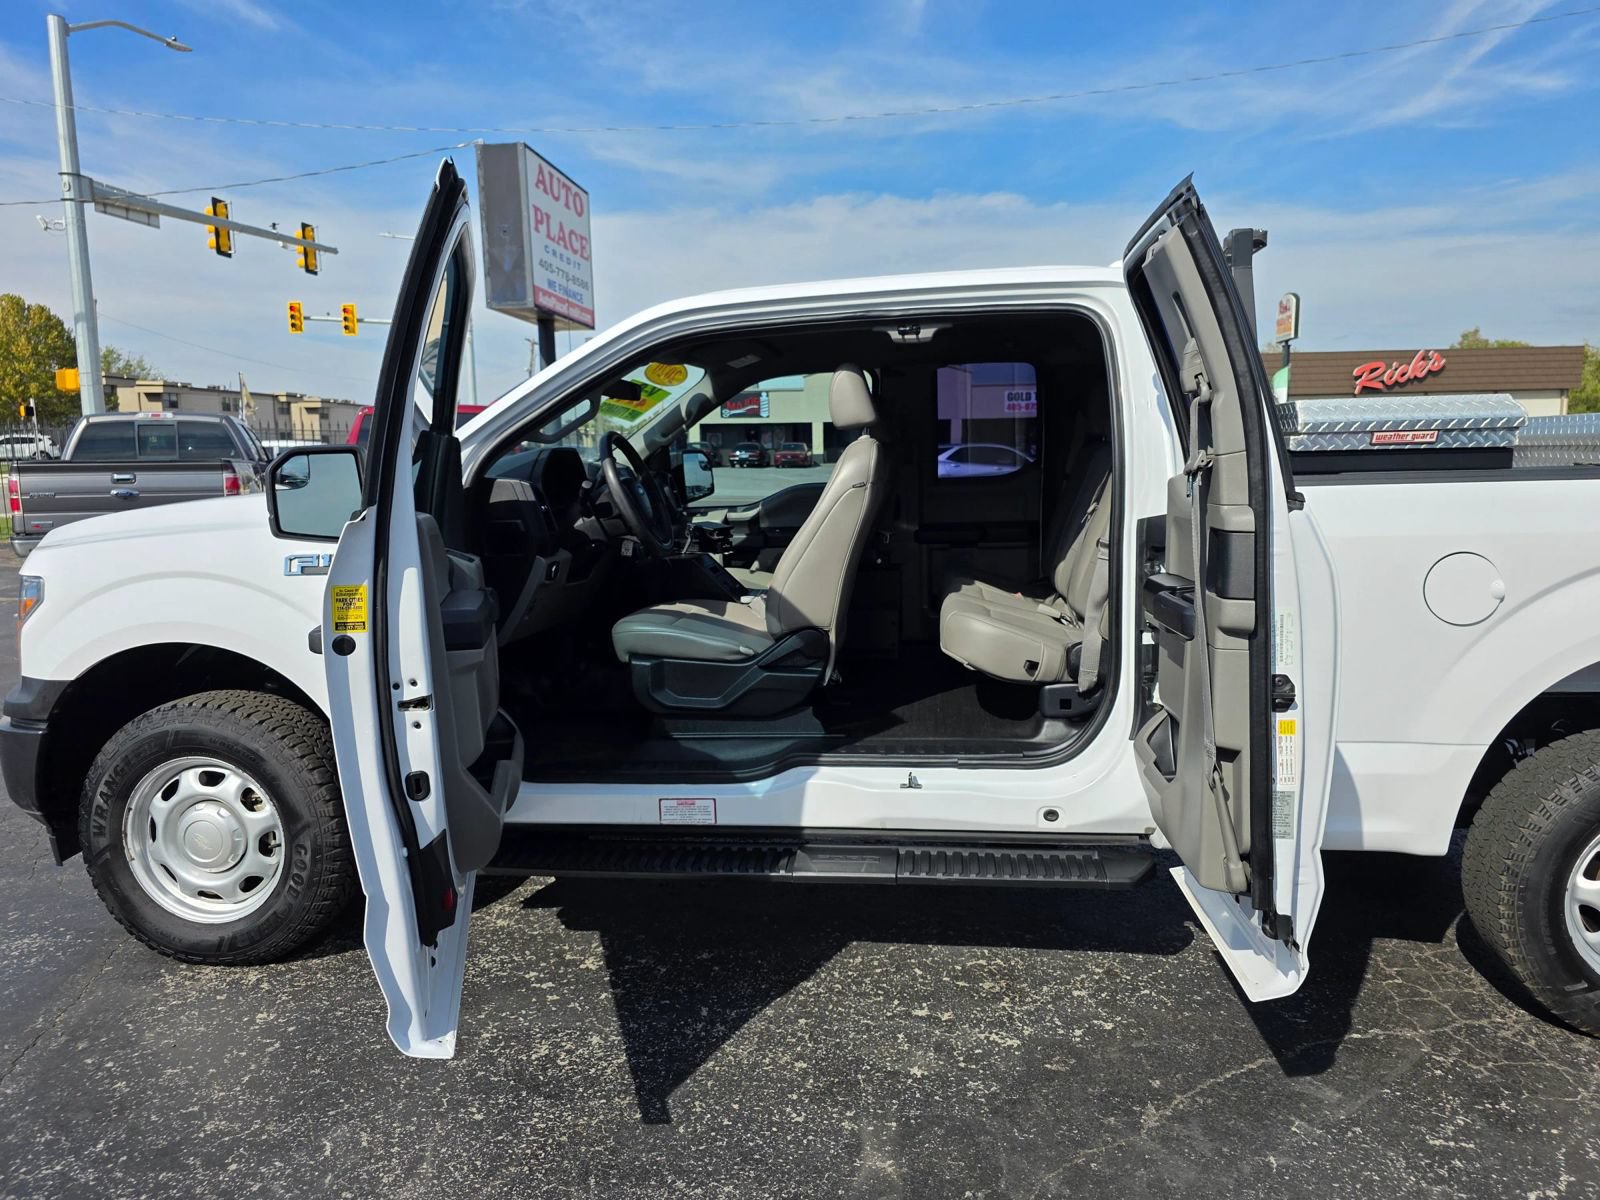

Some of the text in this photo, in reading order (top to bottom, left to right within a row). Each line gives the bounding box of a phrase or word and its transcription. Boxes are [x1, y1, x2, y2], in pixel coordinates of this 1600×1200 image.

[535, 163, 584, 218] AUTO
[532, 204, 589, 261] PLACE
[544, 245, 582, 270] CREDIT
[1353, 350, 1446, 394] Rick's
[1007, 391, 1032, 402] GOLD
[1375, 431, 1436, 442] weather guard
